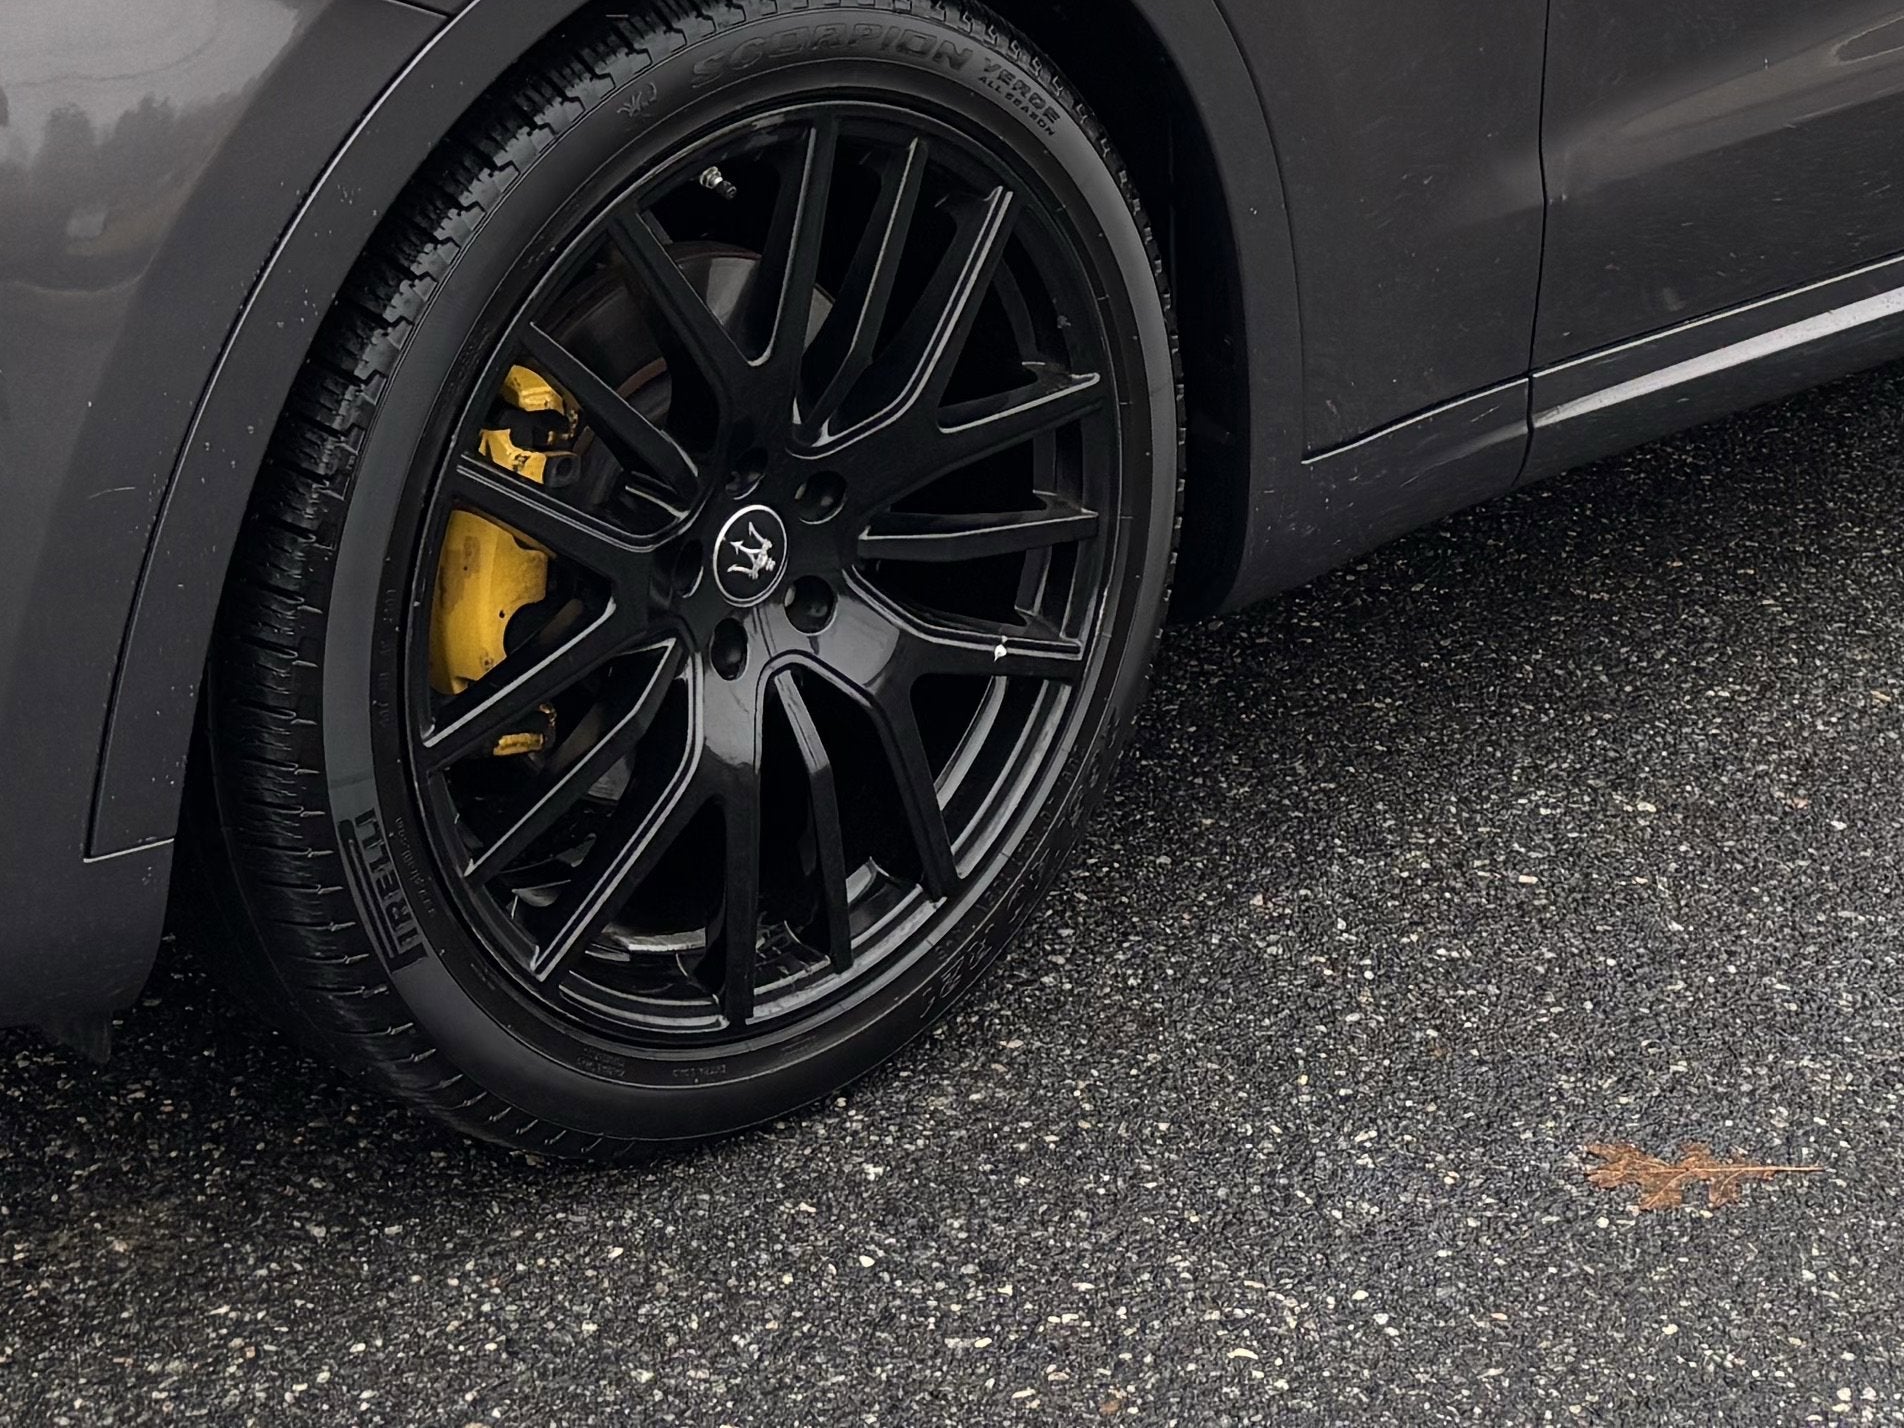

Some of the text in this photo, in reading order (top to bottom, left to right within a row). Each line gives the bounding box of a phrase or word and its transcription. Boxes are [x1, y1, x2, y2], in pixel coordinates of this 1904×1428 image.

[691, 22, 1062, 125] SCORPION VERDE
[977, 75, 1005, 98] ALL
